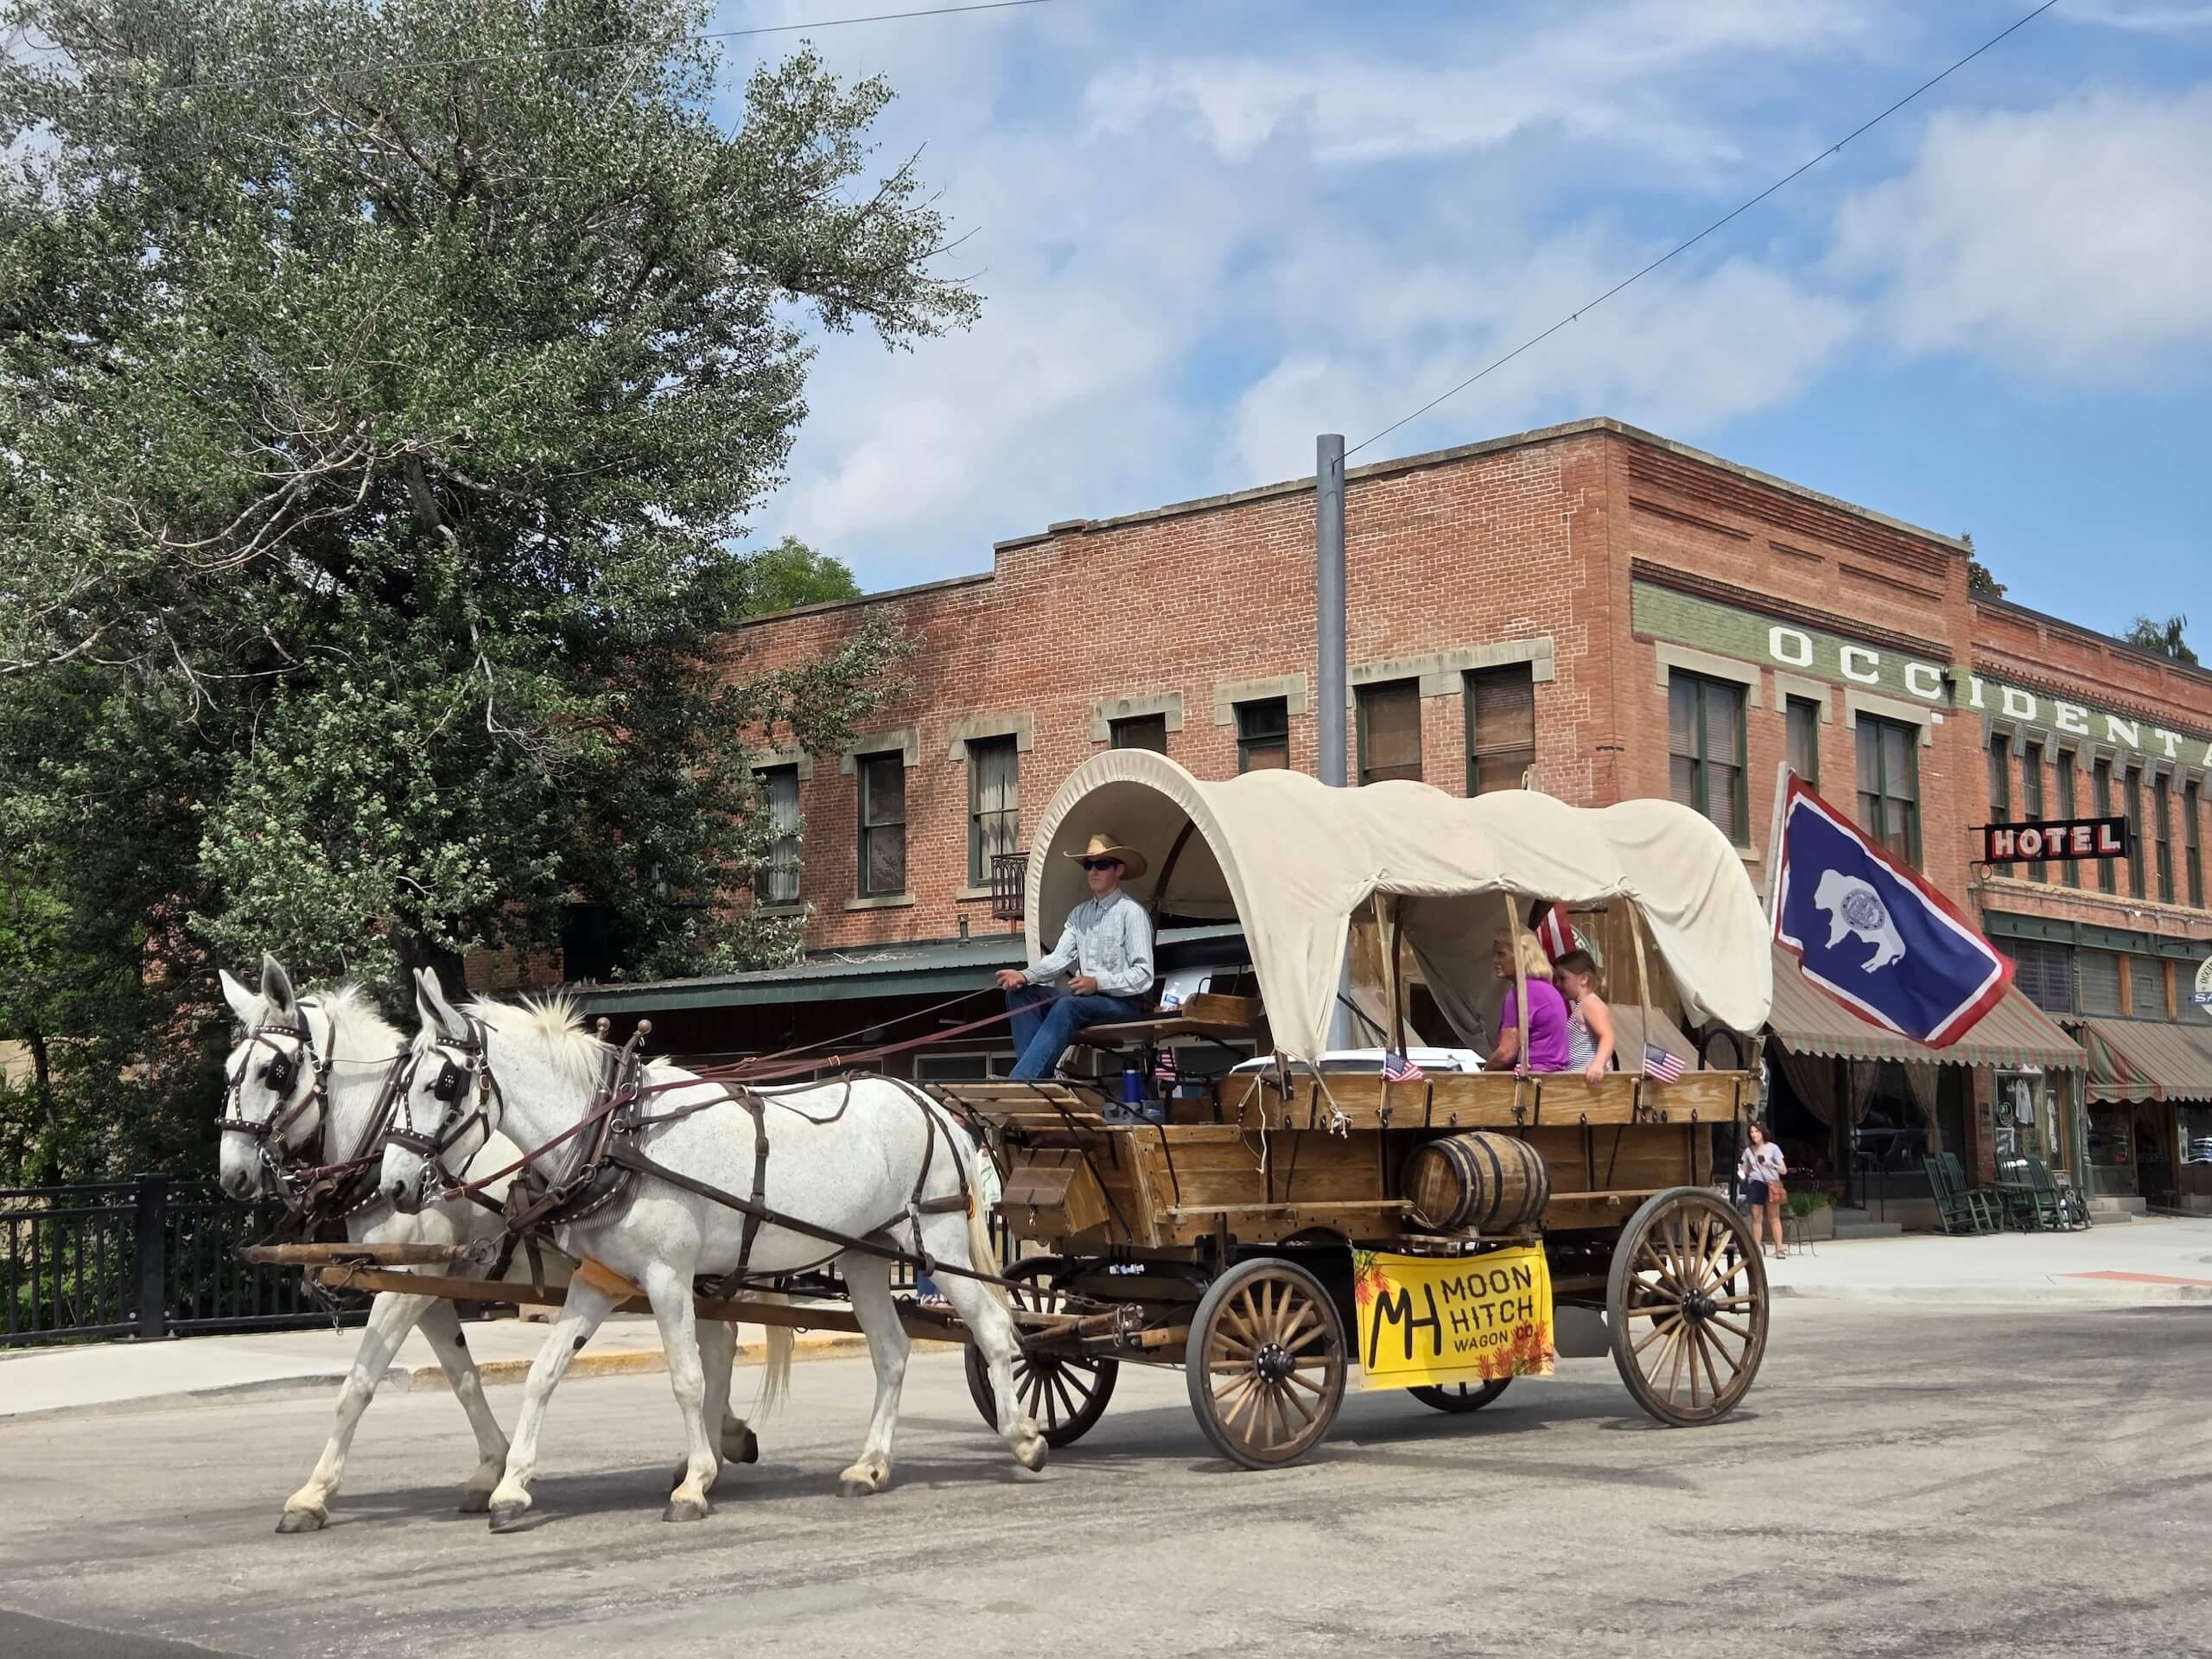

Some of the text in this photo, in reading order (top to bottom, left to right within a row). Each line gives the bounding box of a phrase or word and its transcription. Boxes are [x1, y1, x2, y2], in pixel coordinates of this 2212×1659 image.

[1992, 823, 2121, 858] HOTEL
[1440, 1264, 1532, 1304] MOON
[1369, 1282, 1442, 1369] MH
[1450, 1294, 1533, 1334] HITCH
[1454, 1330, 1508, 1352] WAGON
